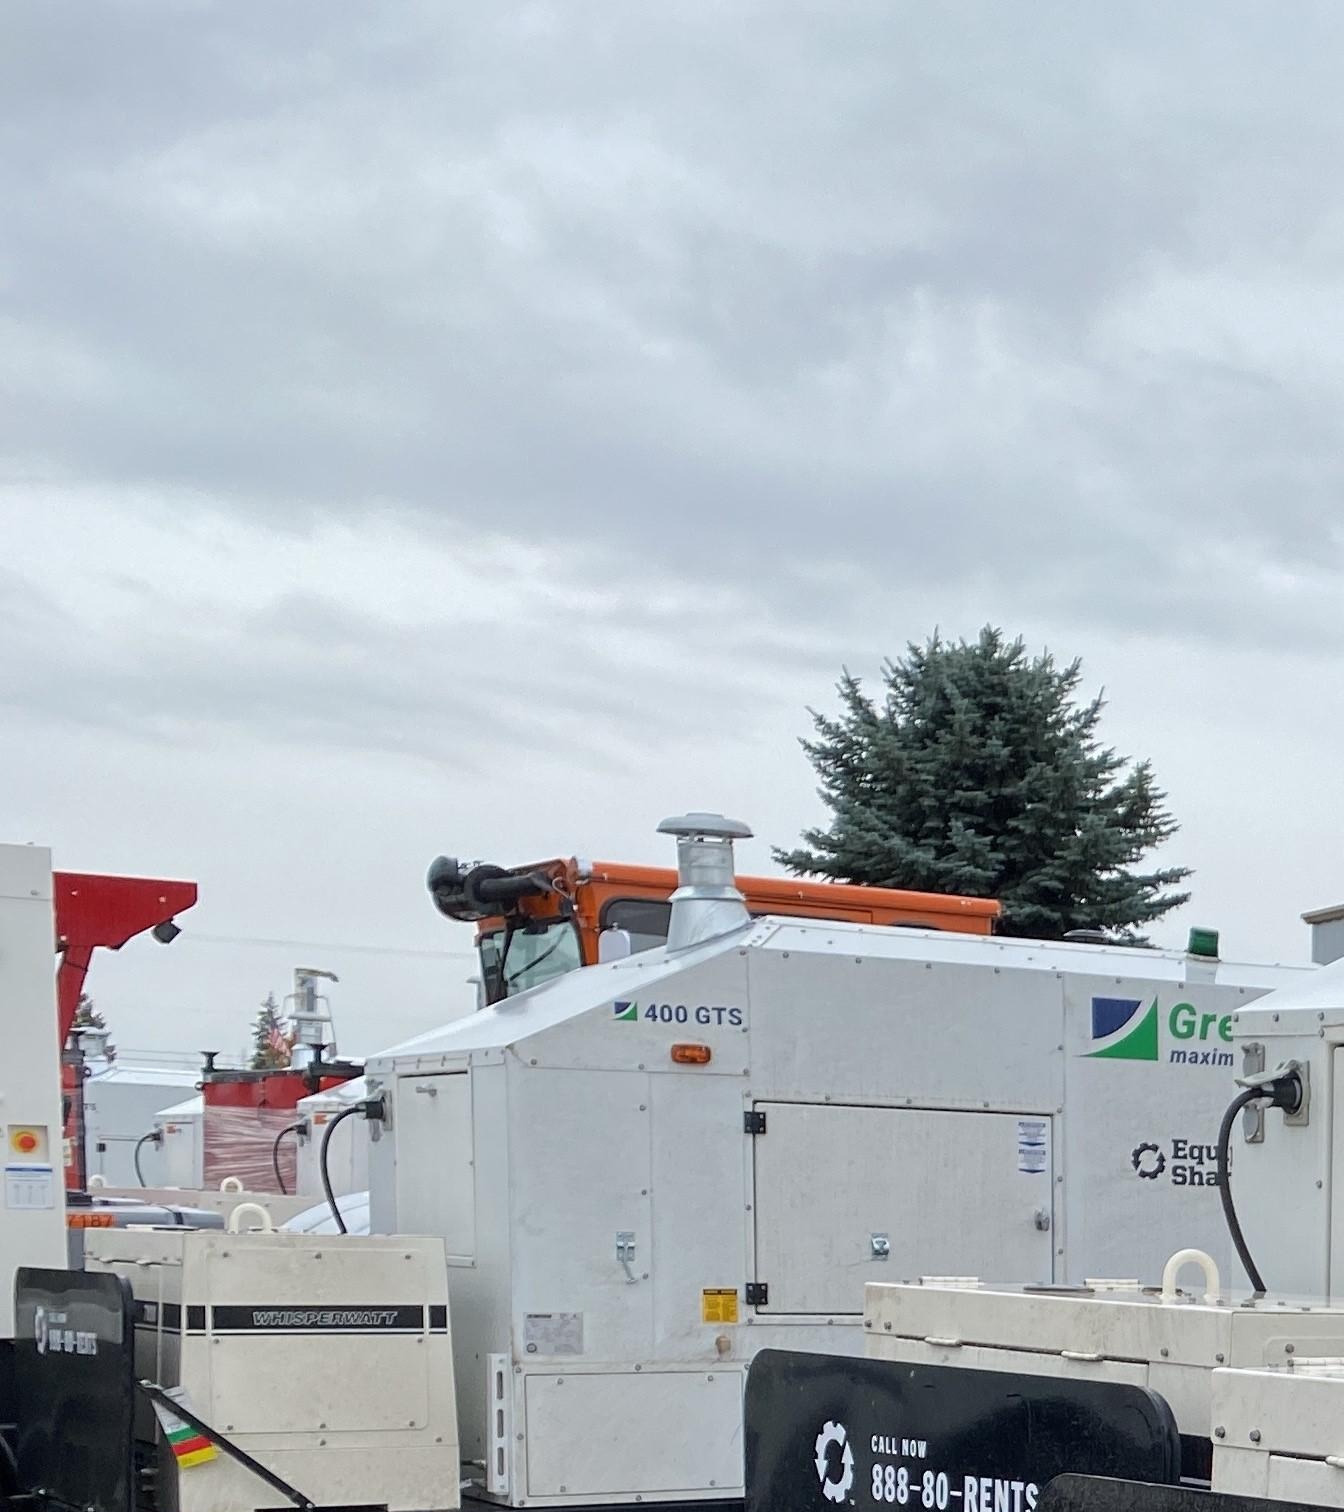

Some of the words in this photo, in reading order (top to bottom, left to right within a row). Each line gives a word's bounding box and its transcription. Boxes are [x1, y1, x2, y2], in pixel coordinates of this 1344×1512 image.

[644, 1003, 688, 1023] 400
[695, 1006, 743, 1026] GTS
[252, 1311, 398, 1327] WHISPERWATT
[871, 1434, 898, 1455] CALL
[901, 1438, 927, 1459] NOW
